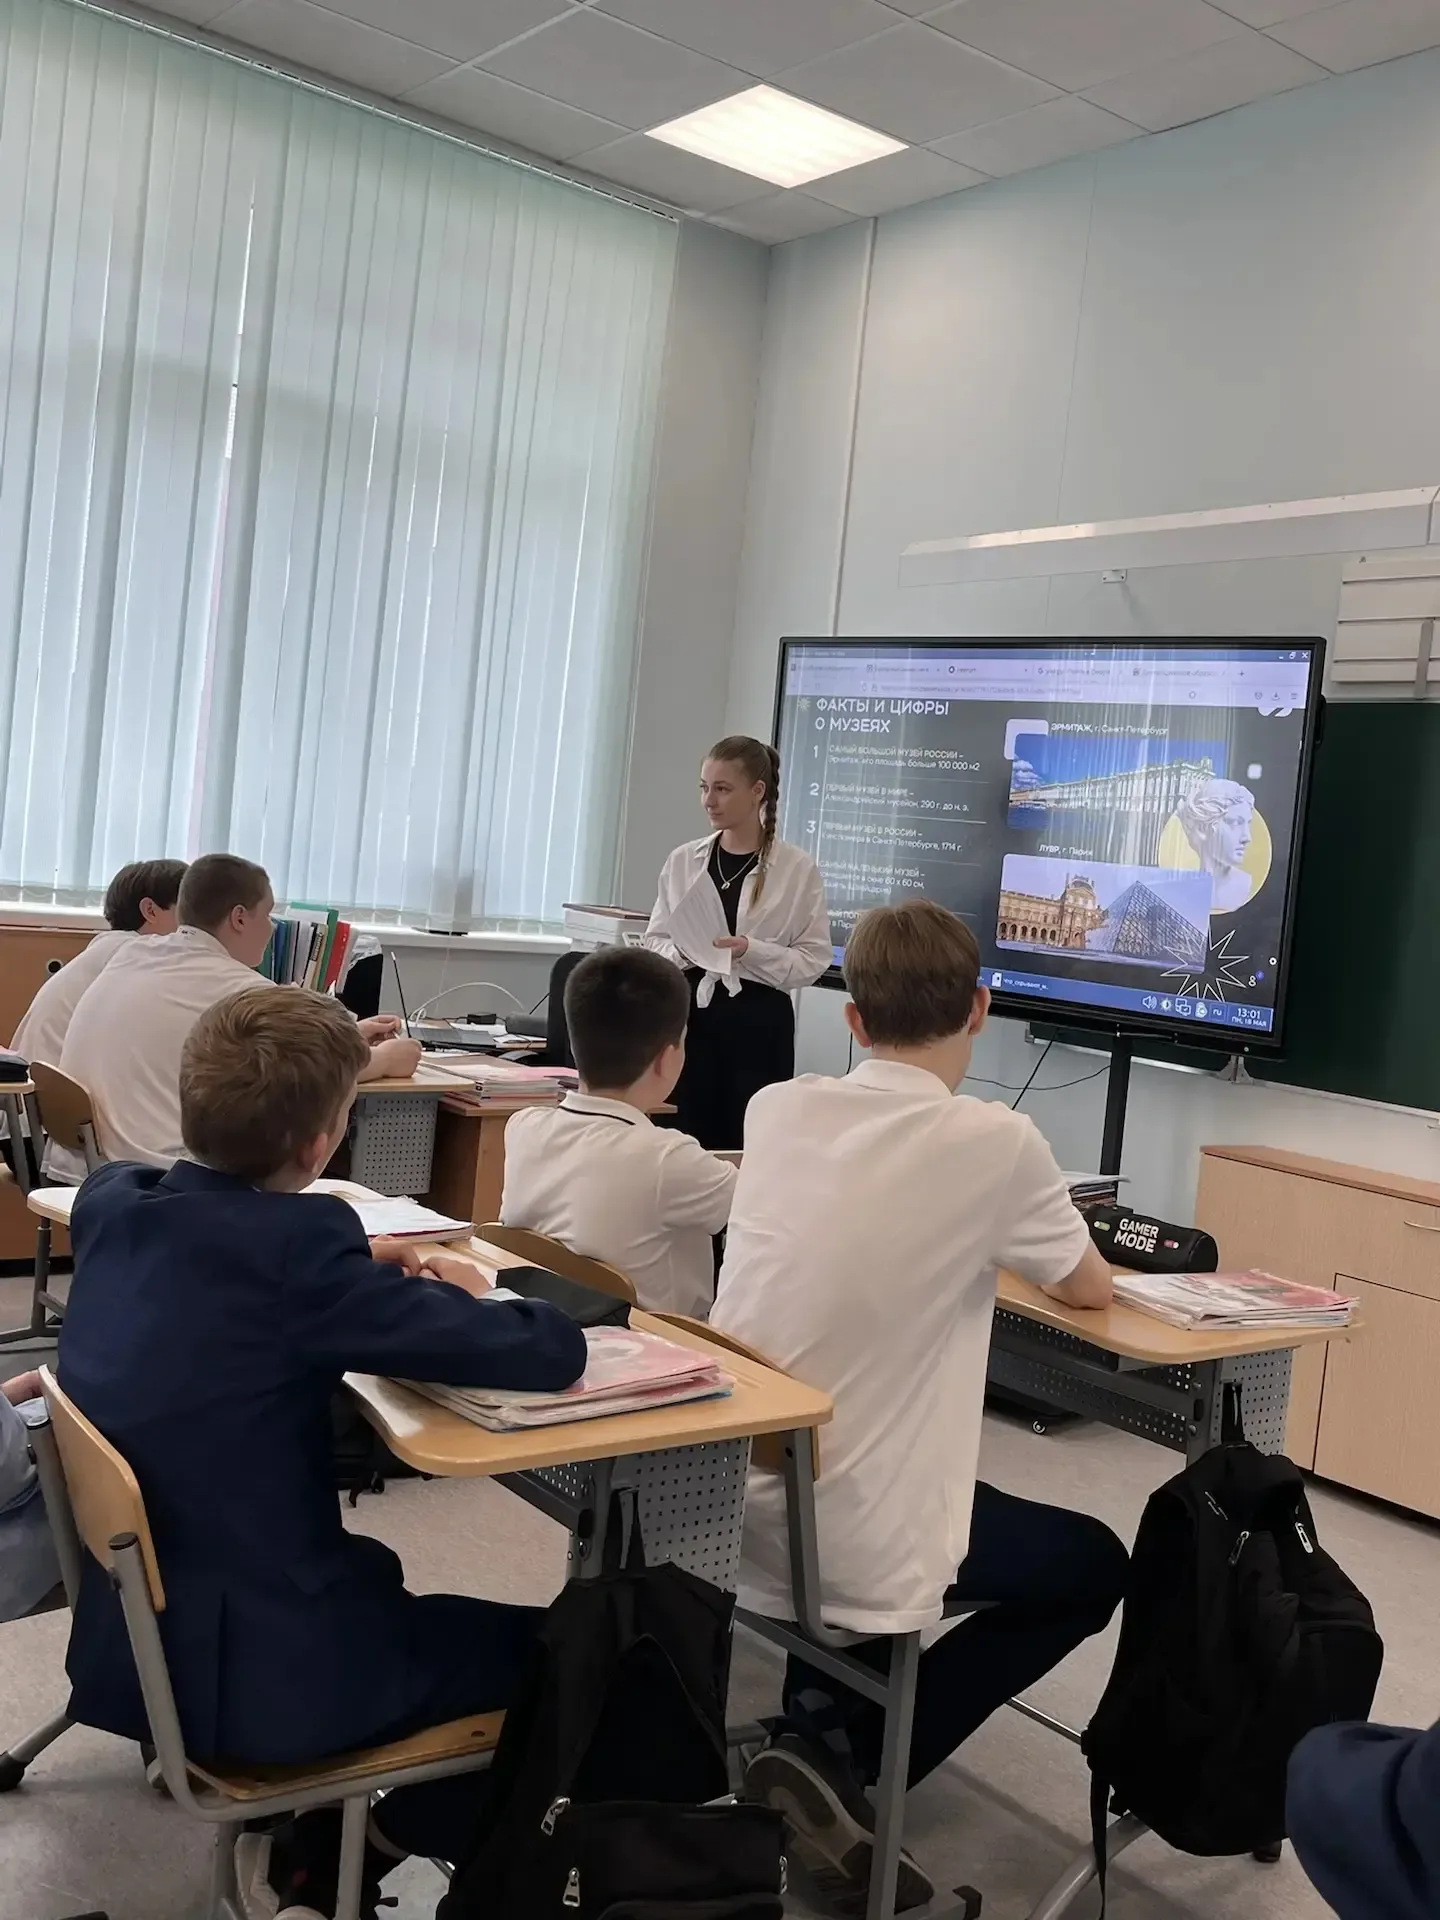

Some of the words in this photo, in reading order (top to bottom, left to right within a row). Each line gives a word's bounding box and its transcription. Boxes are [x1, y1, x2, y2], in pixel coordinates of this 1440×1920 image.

[816, 697, 869, 713] ФАКТЫ
[874, 699, 885, 713] И
[890, 700, 949, 716] ЦИФРЫ
[815, 717, 825, 730] О
[829, 717, 891, 733] МУЗЕЯХ
[813, 745, 819, 758] 1
[924, 750, 958, 759] РОССИИ
[938, 761, 951, 769] 100
[951, 761, 968, 770] 000
[810, 783, 820, 796] 2
[920, 800, 935, 808] 290
[806, 820, 816, 833] 3
[884, 827, 916, 837] РОССИИ
[941, 842, 956, 851] 1714
[901, 878, 912, 887] 60
[1237, 1007, 1260, 1019] 13:01
[1119, 1218, 1159, 1239] GAMER
[1114, 1230, 1157, 1253] MODE
